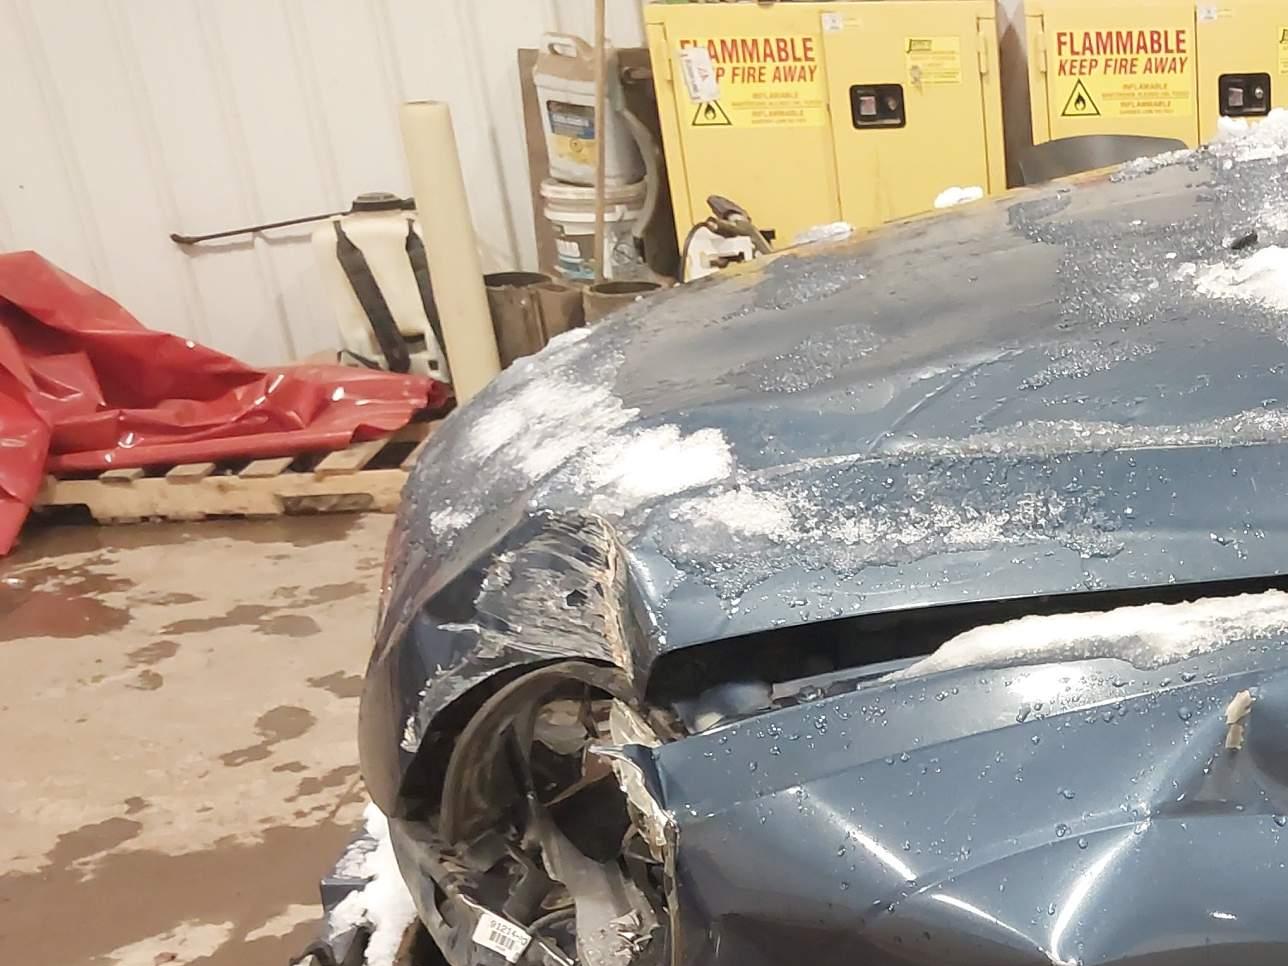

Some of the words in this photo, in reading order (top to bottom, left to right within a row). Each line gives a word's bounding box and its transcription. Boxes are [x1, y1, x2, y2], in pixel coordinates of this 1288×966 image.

[680, 38, 816, 64] AMMABLE
[1056, 30, 1187, 56] FLAMMABLE
[731, 66, 767, 84] FIRE
[772, 65, 817, 83] AWAY
[1058, 59, 1098, 76] KEEP
[1103, 58, 1139, 75] FIRE
[1143, 57, 1188, 75] AWAY
